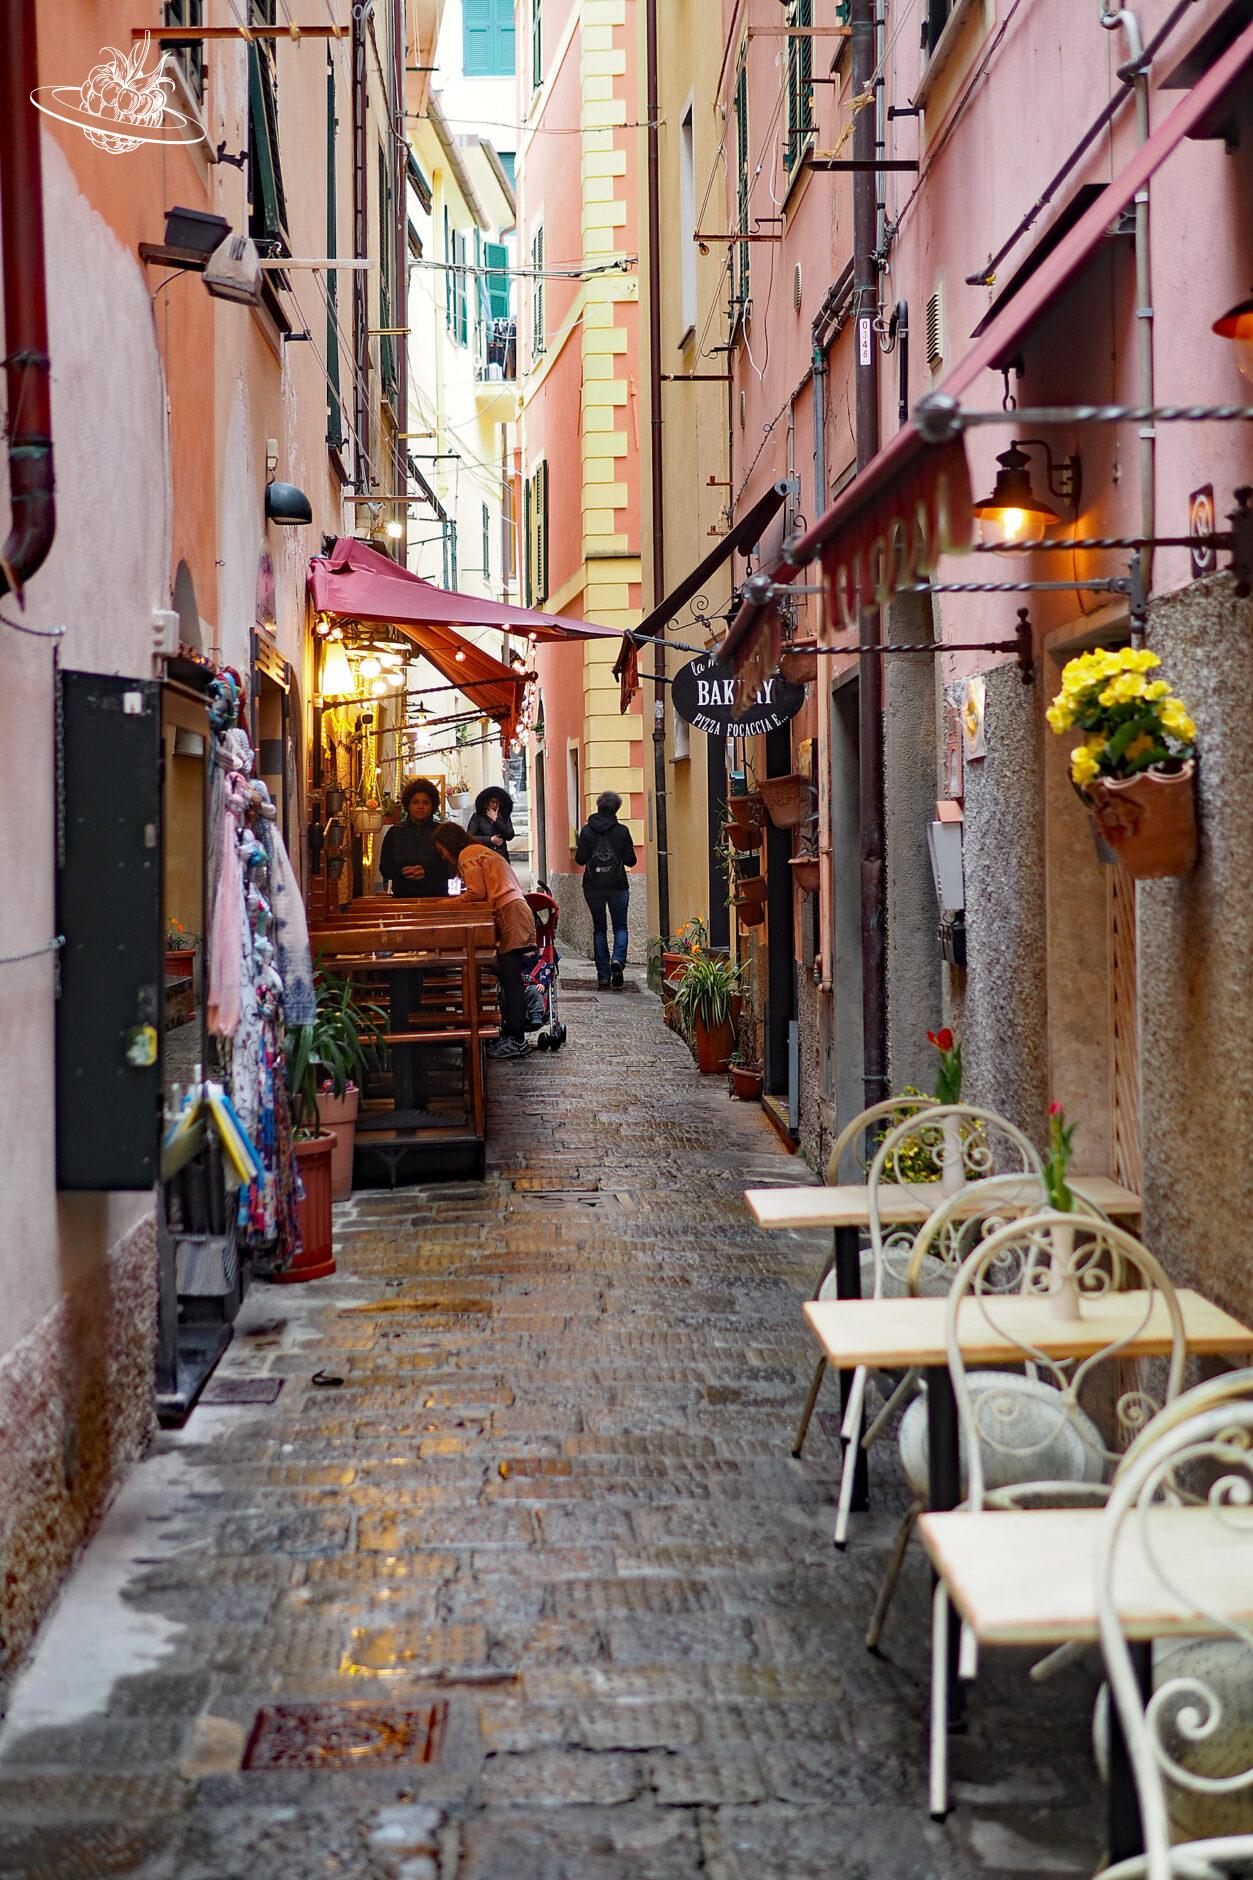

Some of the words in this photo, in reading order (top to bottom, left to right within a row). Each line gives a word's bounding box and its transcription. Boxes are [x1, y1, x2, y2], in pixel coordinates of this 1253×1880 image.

[690, 661, 705, 676] la
[697, 679, 774, 706] BAKY
[692, 713, 720, 735] PIZZA
[727, 718, 772, 737] FOCACCIA
